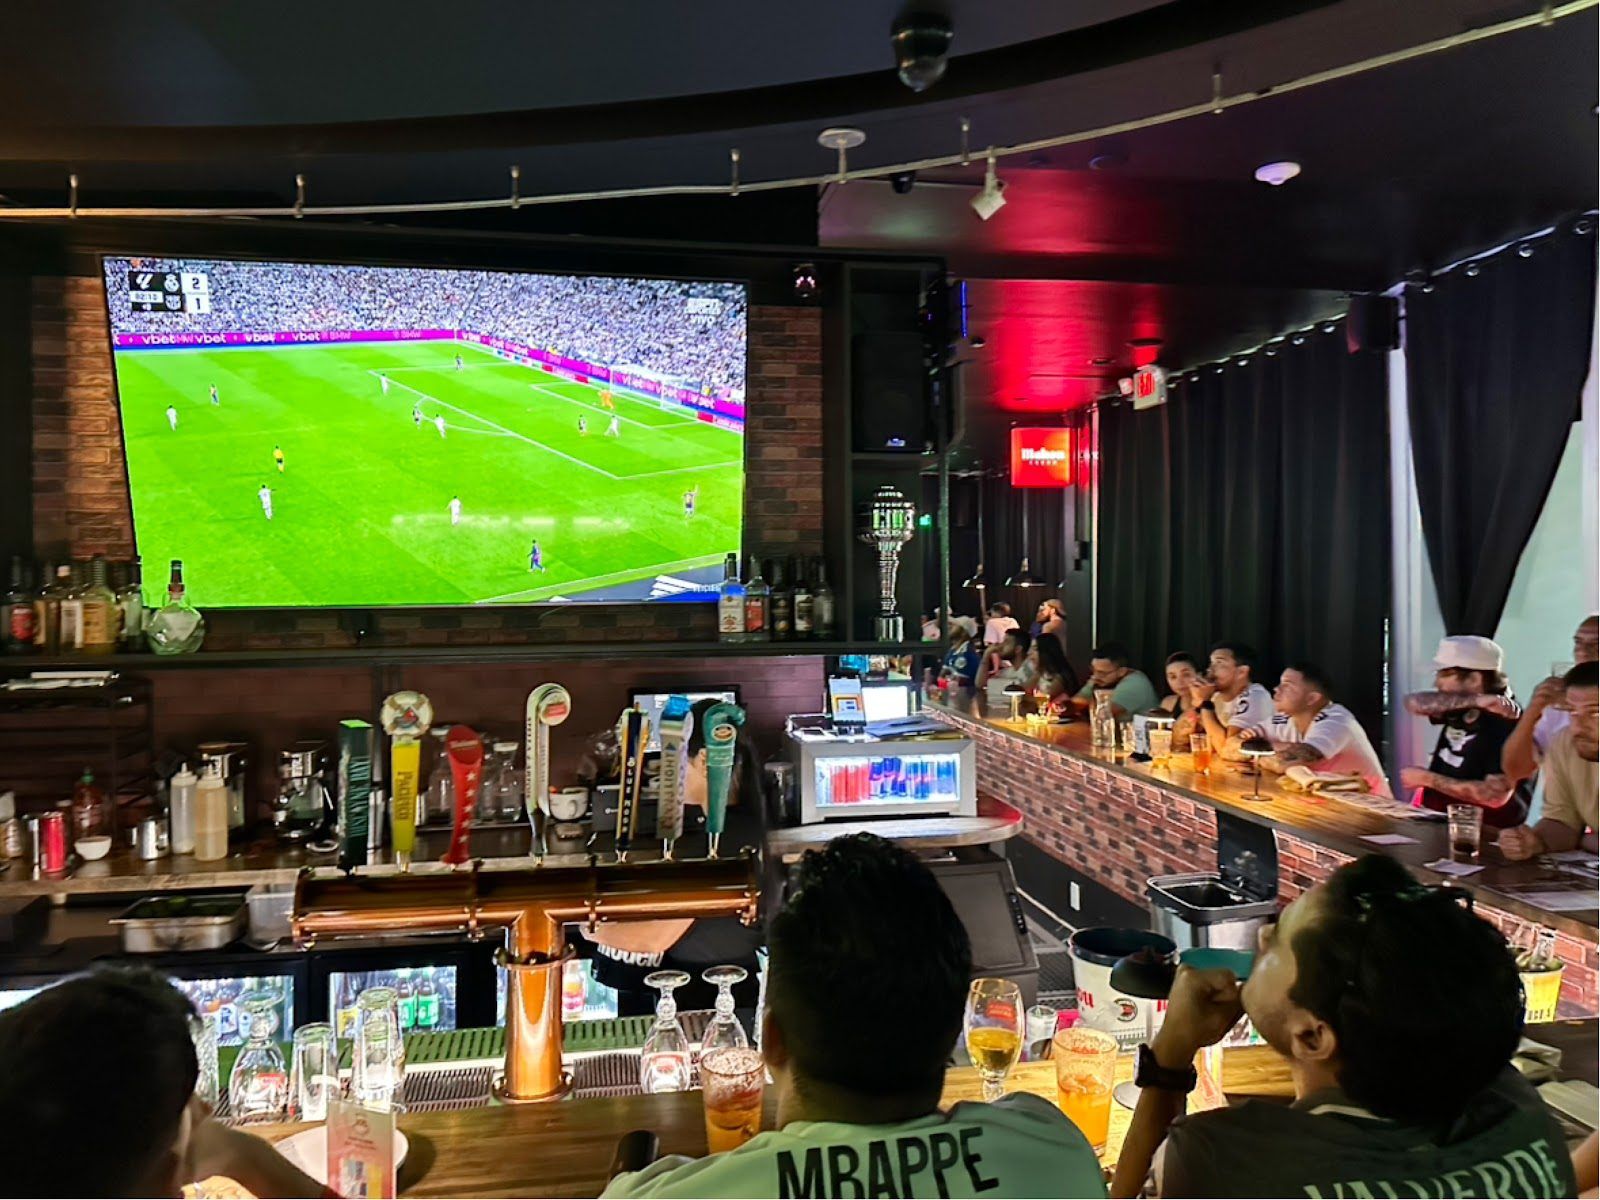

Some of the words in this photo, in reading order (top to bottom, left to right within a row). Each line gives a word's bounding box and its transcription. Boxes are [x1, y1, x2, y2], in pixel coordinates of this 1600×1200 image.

[192, 277, 200, 289] 2
[141, 334, 175, 345] vbet
[195, 333, 226, 344] vbet
[291, 330, 320, 341] vbet
[777, 1126, 999, 1199] MBAPPE
[1303, 1138, 1567, 1199] ERDE
